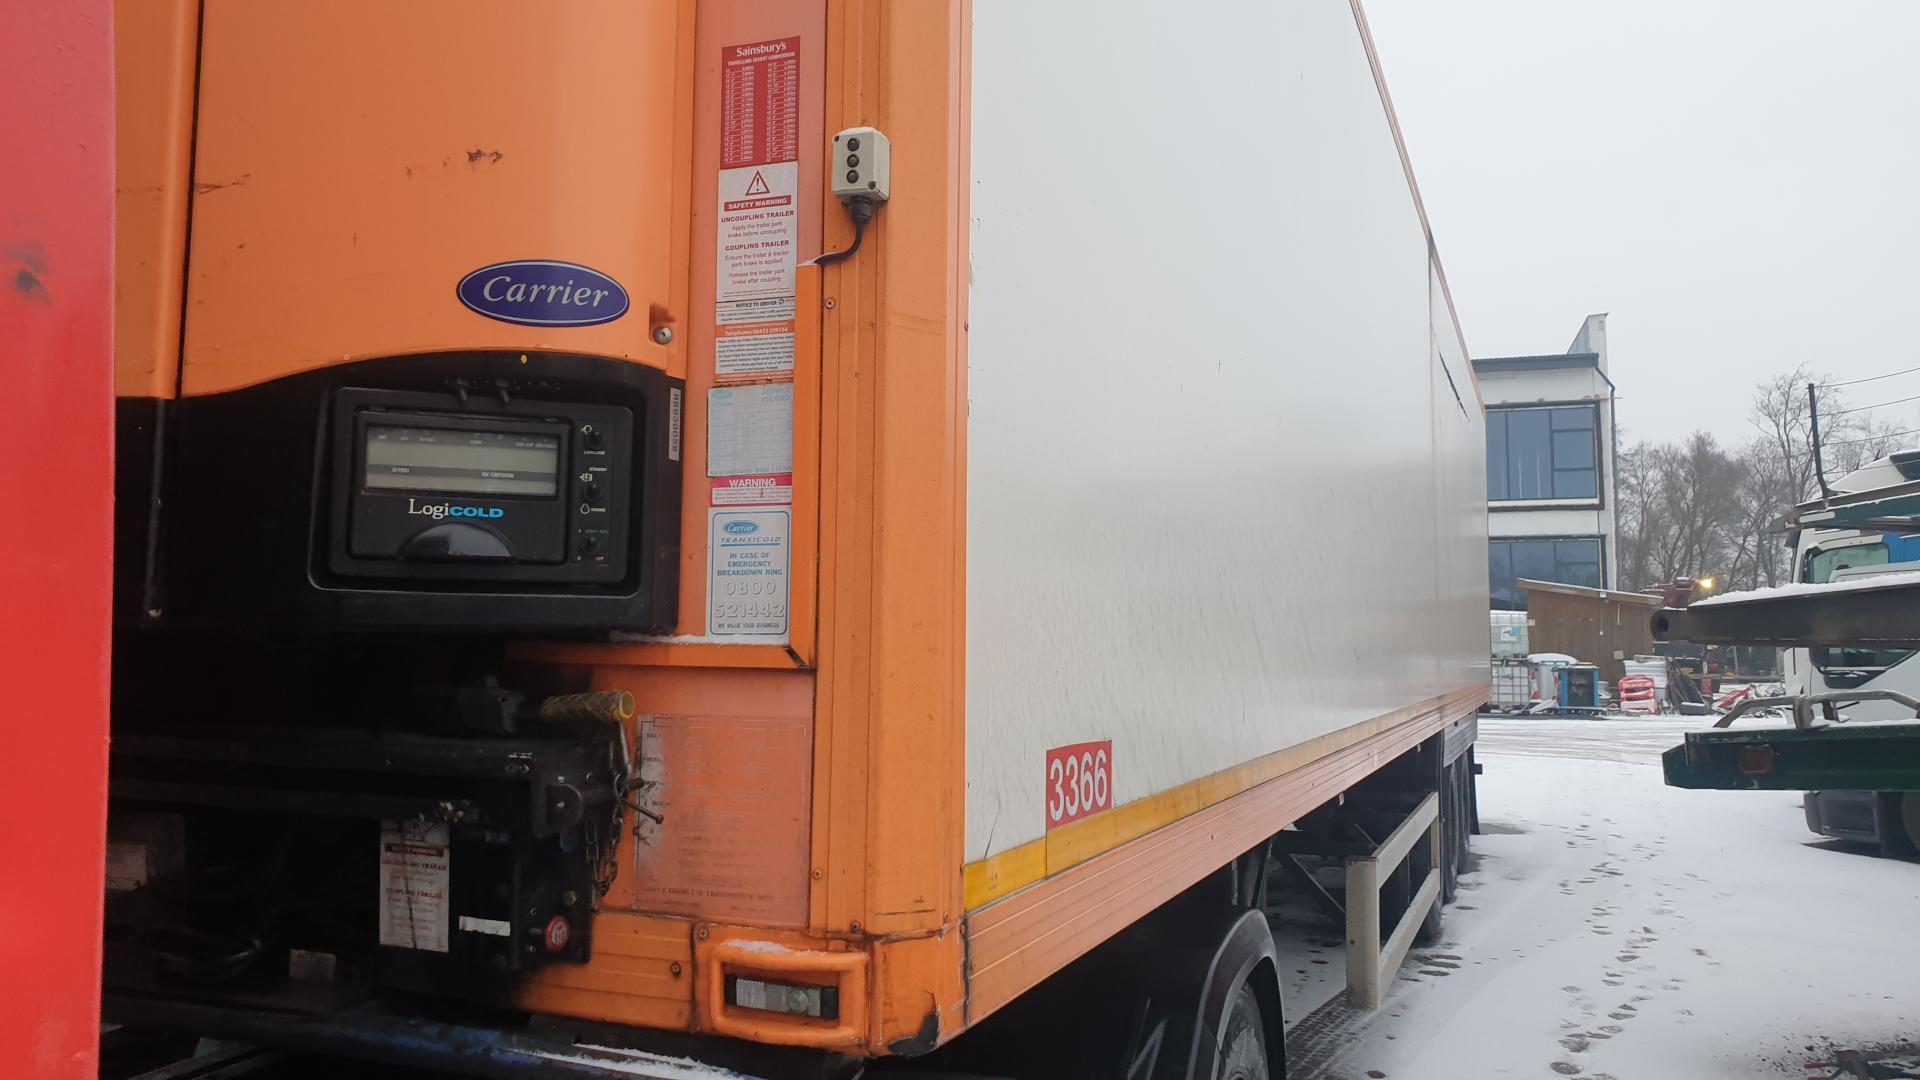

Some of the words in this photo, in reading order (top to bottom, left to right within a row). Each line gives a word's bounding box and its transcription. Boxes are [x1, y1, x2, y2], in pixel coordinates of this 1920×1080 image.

[736, 41, 787, 57] Sainsbury's
[755, 198, 787, 207] WARNING
[721, 213, 764, 223] UNCOUPLING
[766, 210, 794, 218] TRAILER
[725, 243, 759, 251] COUPLING
[482, 274, 609, 308] Carrier
[729, 478, 776, 487] WARNING
[408, 498, 505, 520] LogiCOLD
[726, 522, 755, 534] Carrier
[727, 560, 772, 568] EMERGENCY
[717, 568, 763, 577] BREAKDOWN
[765, 568, 783, 576] RING
[726, 580, 776, 596] 0800
[715, 602, 785, 618] 521442
[1049, 748, 1108, 821] 3366
